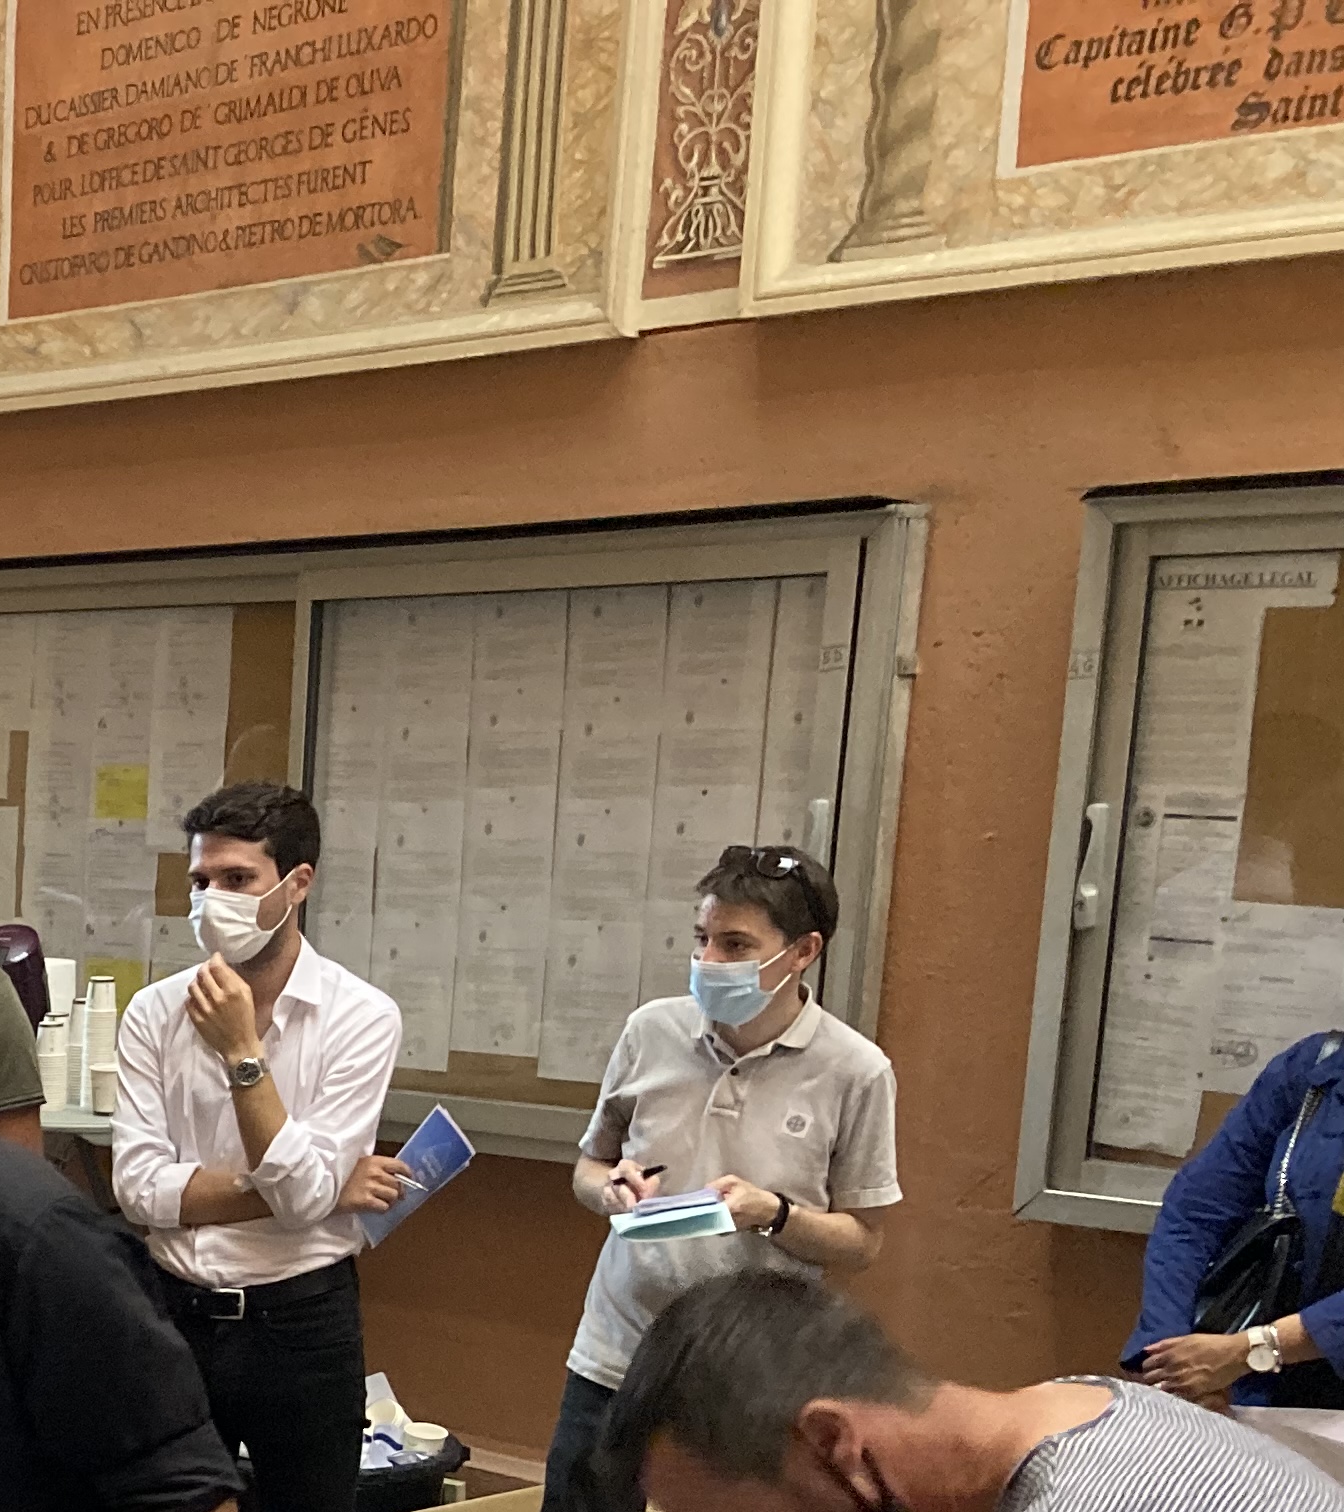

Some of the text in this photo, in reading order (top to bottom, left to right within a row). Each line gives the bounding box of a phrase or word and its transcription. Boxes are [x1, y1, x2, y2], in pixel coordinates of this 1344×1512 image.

[76, 7, 100, 36] EN
[100, 26, 201, 71] DOMENICO
[216, 15, 242, 43] DE
[1035, 16, 1201, 70] Capitaine
[1263, 45, 1344, 82] dans
[24, 102, 51, 130] DU
[125, 66, 211, 107] DAMIANO
[43, 140, 57, 164] &
[66, 132, 89, 158] DE
[214, 84, 308, 126] GRIMALDI
[315, 75, 341, 105] DE
[344, 65, 403, 99] OLIVA
[1231, 85, 1344, 131] Saint
[32, 176, 77, 207] POUR
[142, 156, 167, 184] DE
[168, 144, 223, 179] SAINT
[223, 128, 304, 168] GEORGES
[308, 122, 336, 151] DE
[62, 159, 373, 240] LES PREMIERS ARCHITECTES FURENT
[114, 244, 136, 271] DE
[137, 231, 217, 265] GANDINO
[218, 226, 232, 252] &
[234, 217, 295, 250] PIETRO
[298, 212, 324, 239] DE
